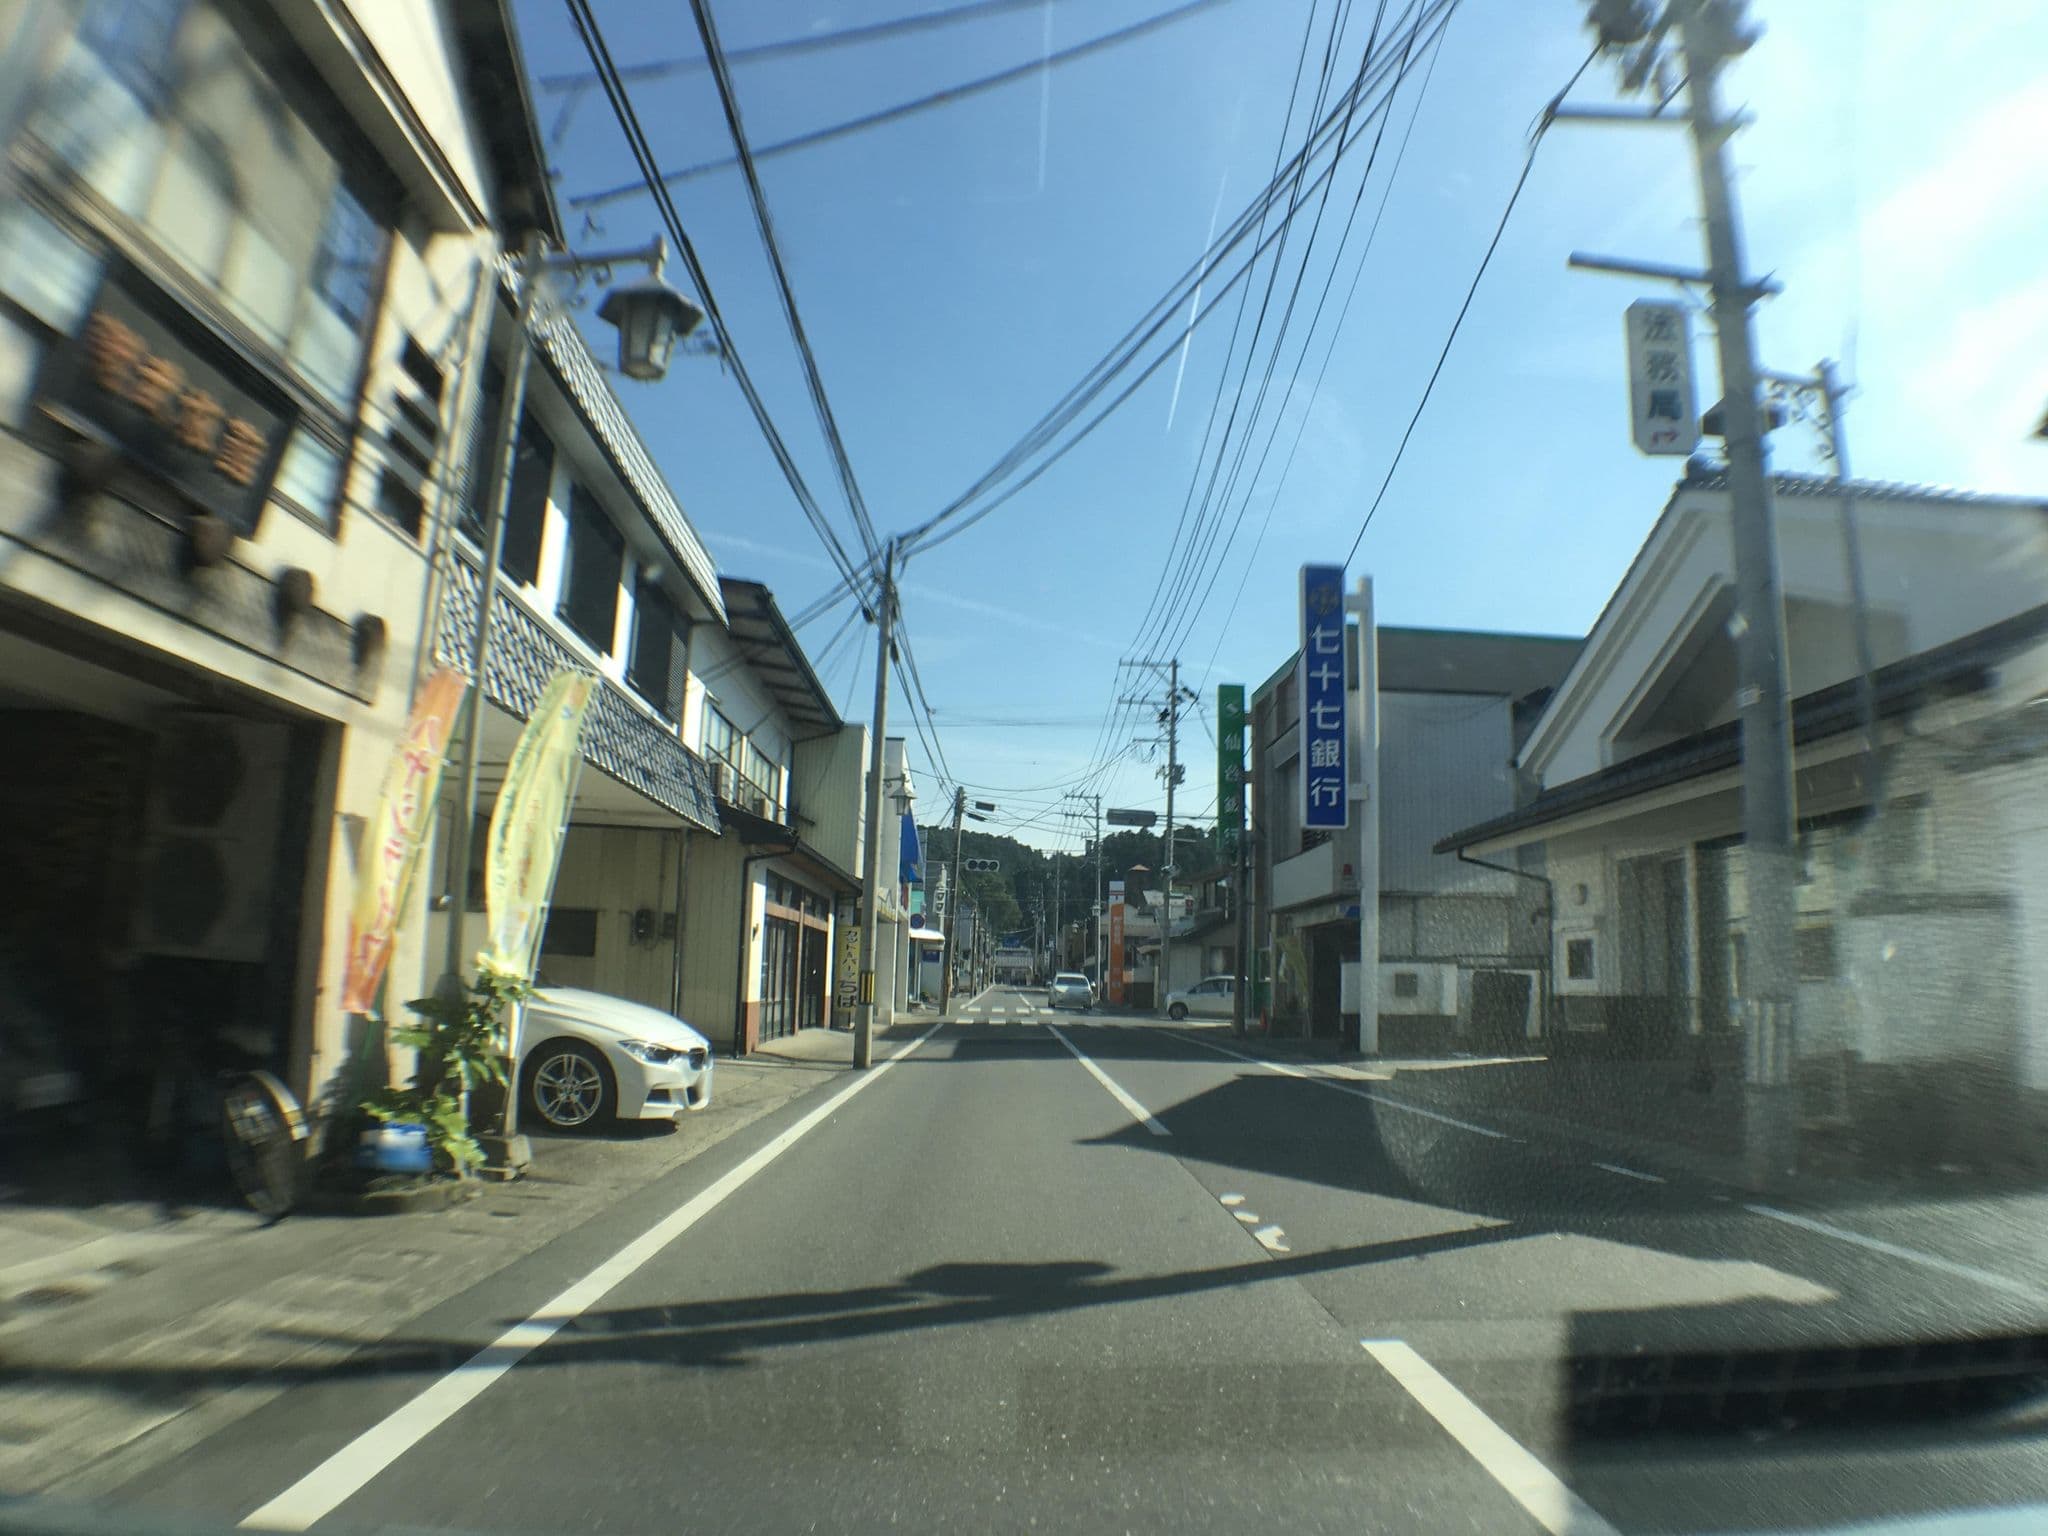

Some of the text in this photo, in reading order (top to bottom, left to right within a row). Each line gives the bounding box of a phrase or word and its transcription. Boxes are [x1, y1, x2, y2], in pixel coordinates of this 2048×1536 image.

[1309, 623, 1341, 807] 七十七銀行
